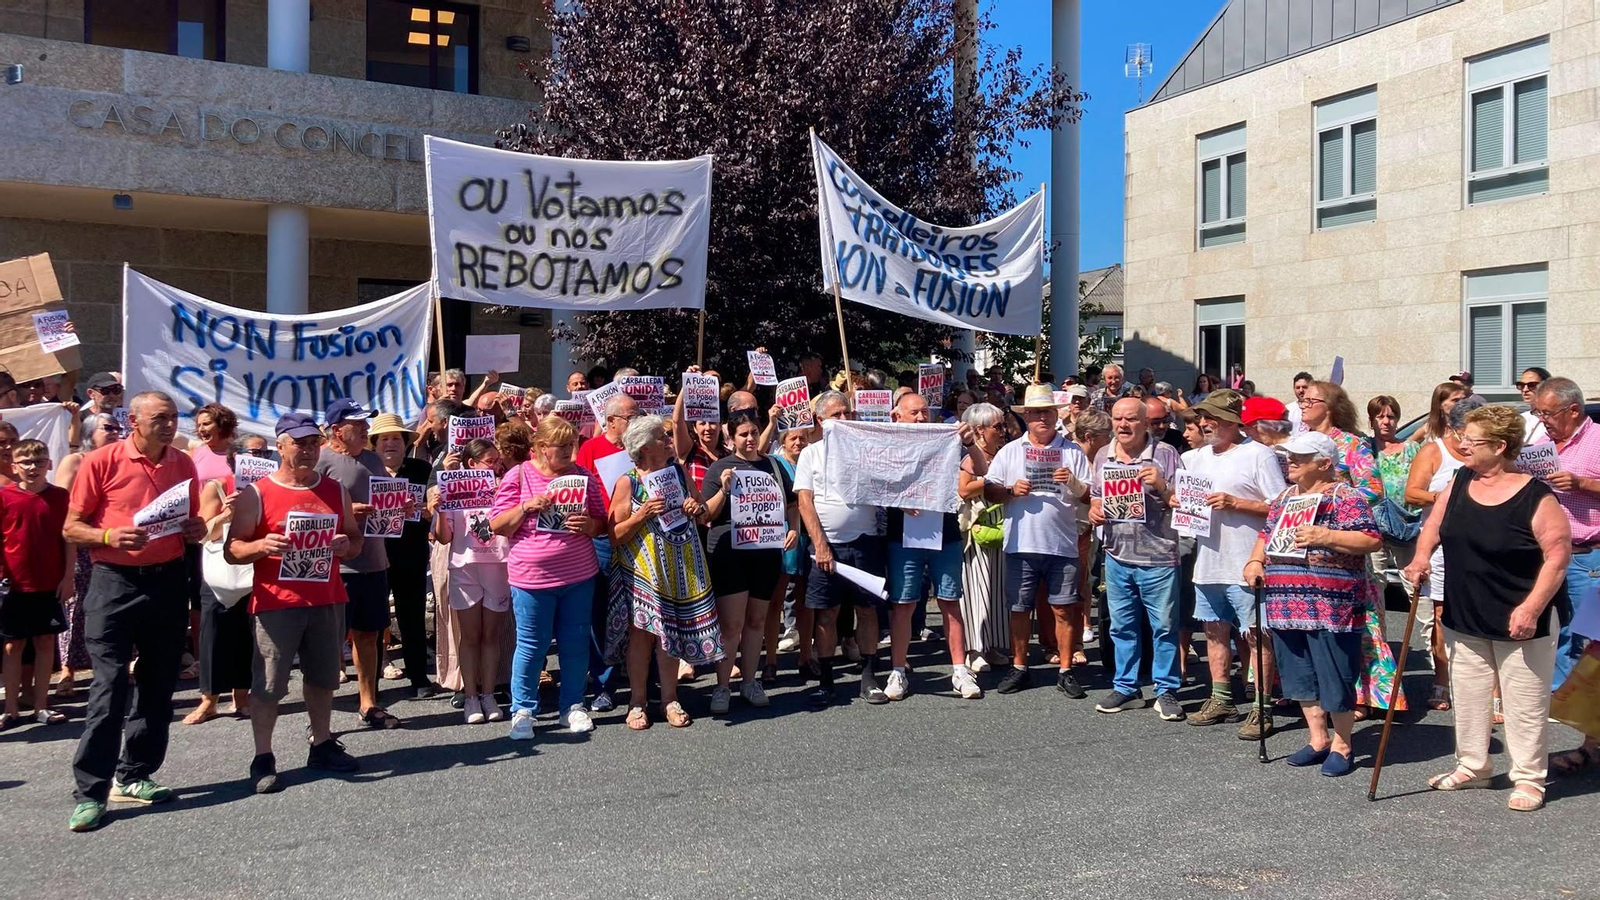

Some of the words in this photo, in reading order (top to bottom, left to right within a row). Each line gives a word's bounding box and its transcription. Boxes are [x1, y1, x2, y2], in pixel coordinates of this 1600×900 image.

[66, 99, 187, 139] CASA
[201, 113, 261, 146] DO
[458, 178, 508, 215] OU
[551, 226, 614, 251] nos
[454, 242, 685, 297] REBOTAMOS
[913, 268, 1011, 318] FUSION
[171, 302, 277, 361] NON
[292, 321, 404, 362] Fusion
[621, 376, 662, 385] CARBALLEDA
[686, 377, 691, 386] A
[920, 374, 943, 389] NON
[625, 384, 659, 395] UNIDA
[592, 397, 598, 405] A
[776, 387, 808, 408] NON
[687, 408, 702, 417] NON
[451, 416, 494, 427] CARBALLEDA
[456, 426, 492, 439] UNIDA
[1025, 448, 1061, 456] CARBALLEDA
[1520, 447, 1554, 461] FUSIÓN
[441, 470, 493, 481] CARBALLEDA
[735, 477, 744, 490] A
[745, 475, 777, 488] FUSIÓN
[1179, 475, 1185, 485] A
[1186, 475, 1213, 490] FUSIÓN
[371, 481, 407, 494] CARBALLEDA
[447, 478, 490, 494] UNIDA
[649, 479, 656, 489] A
[1104, 478, 1143, 497] NON
[371, 491, 408, 510] NON
[1104, 497, 1114, 506] SE
[1115, 493, 1143, 503] VENDE!!
[739, 504, 750, 513] DO
[751, 502, 781, 513] POBO!!
[289, 518, 335, 532] CARBALLEDA
[1174, 514, 1192, 525] NON
[1278, 506, 1317, 530] NON
[288, 529, 335, 551] NON
[736, 527, 760, 543] NON
[285, 551, 297, 562] SE
[300, 547, 331, 560] VENDE!!
